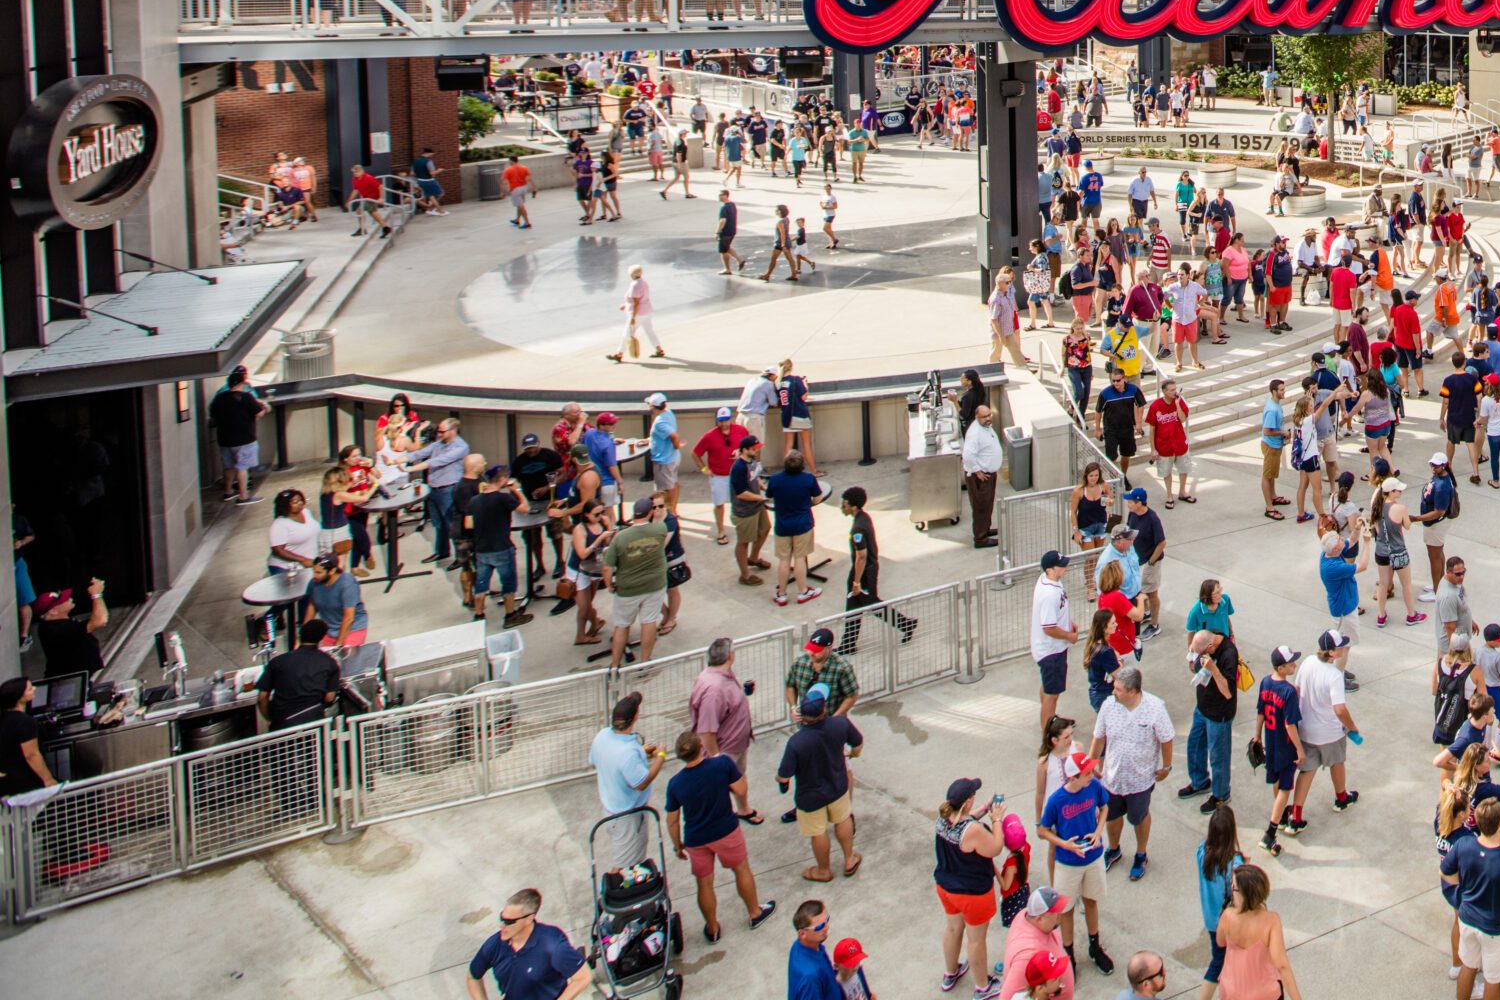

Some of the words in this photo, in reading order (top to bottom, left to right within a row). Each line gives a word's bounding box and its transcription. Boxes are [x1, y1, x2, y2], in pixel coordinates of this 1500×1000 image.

[1105, 135, 1136, 144] SERIES
[1138, 135, 1167, 144] TITLES
[1179, 133, 1221, 149] 1914
[1231, 134, 1273, 151] 1957
[63, 129, 102, 184] Yard
[101, 123, 146, 169] House
[1263, 703, 1275, 731] 5
